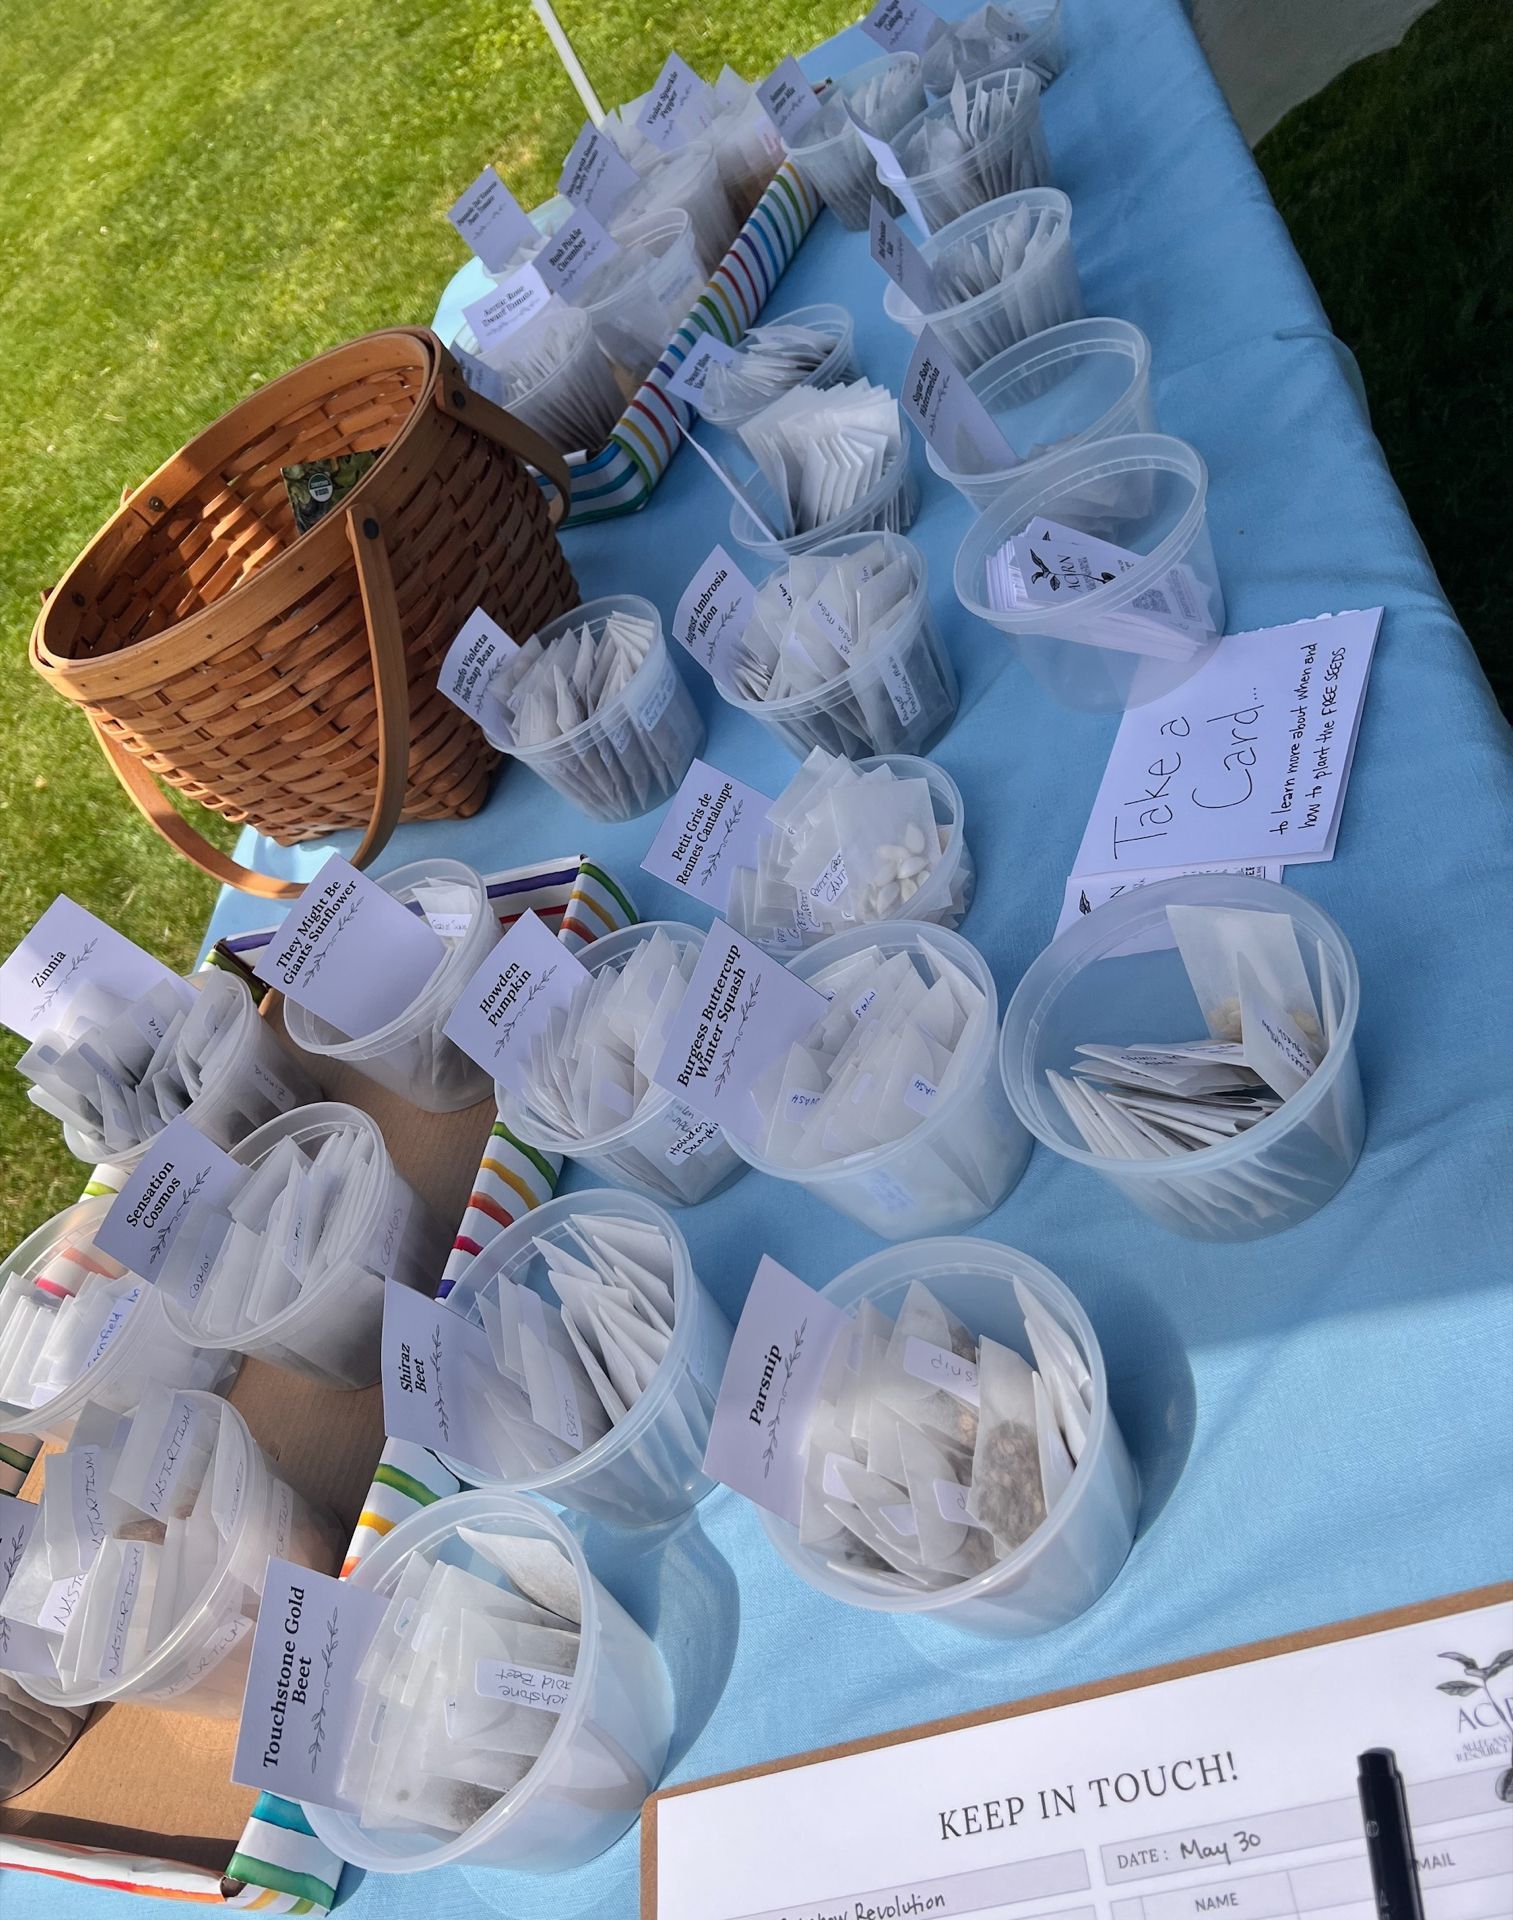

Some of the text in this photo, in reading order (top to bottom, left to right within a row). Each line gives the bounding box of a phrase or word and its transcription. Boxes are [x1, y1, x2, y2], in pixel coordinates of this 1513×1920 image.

[660, 90, 677, 119] Pepper
[557, 237, 587, 272] Cucumber
[921, 357, 932, 378] Baby
[685, 568, 728, 647] August Ambrosia
[697, 603, 718, 637] Melon
[461, 643, 496, 705] Pole Snap Bean
[463, 632, 489, 663] Violetta
[1303, 642, 1318, 666] and
[1297, 666, 1312, 700] when
[1291, 702, 1308, 739] about
[1297, 646, 1347, 830] how to plant the FREE SEEDS
[1287, 740, 1300, 777] more
[1113, 715, 1191, 860] Take a
[1279, 780, 1295, 817] learn
[672, 792, 713, 862] Petit Gris de
[676, 781, 733, 886] Rennes Cantaloupe
[276, 878, 342, 971] They Might Be
[283, 878, 358, 986] Giants Sunflower
[31, 949, 67, 989] Zinnia
[479, 960, 520, 1015] Howden
[488, 968, 532, 1028] Pumpkin
[677, 1024, 706, 1088] Burgess
[700, 943, 740, 1024] Buttercup
[695, 966, 746, 1081] Winter Squash
[126, 1159, 175, 1229] Sensation
[142, 1175, 181, 1231] Cosmos
[400, 1343, 413, 1393] Shiraz
[414, 1358, 427, 1394] Beet
[749, 1345, 783, 1426] Parsnip
[85, 1450, 107, 1550] ASTURTIUM
[263, 1586, 306, 1768] Touchstone Gold
[292, 1655, 312, 1706] Beet
[938, 1751, 1239, 1840] KEEP IN TOUCH!
[1180, 1839, 1231, 1865] May
[1234, 1831, 1261, 1850] 30
[855, 1893, 946, 1920] Revolution
[1195, 1892, 1239, 1913] NAME
